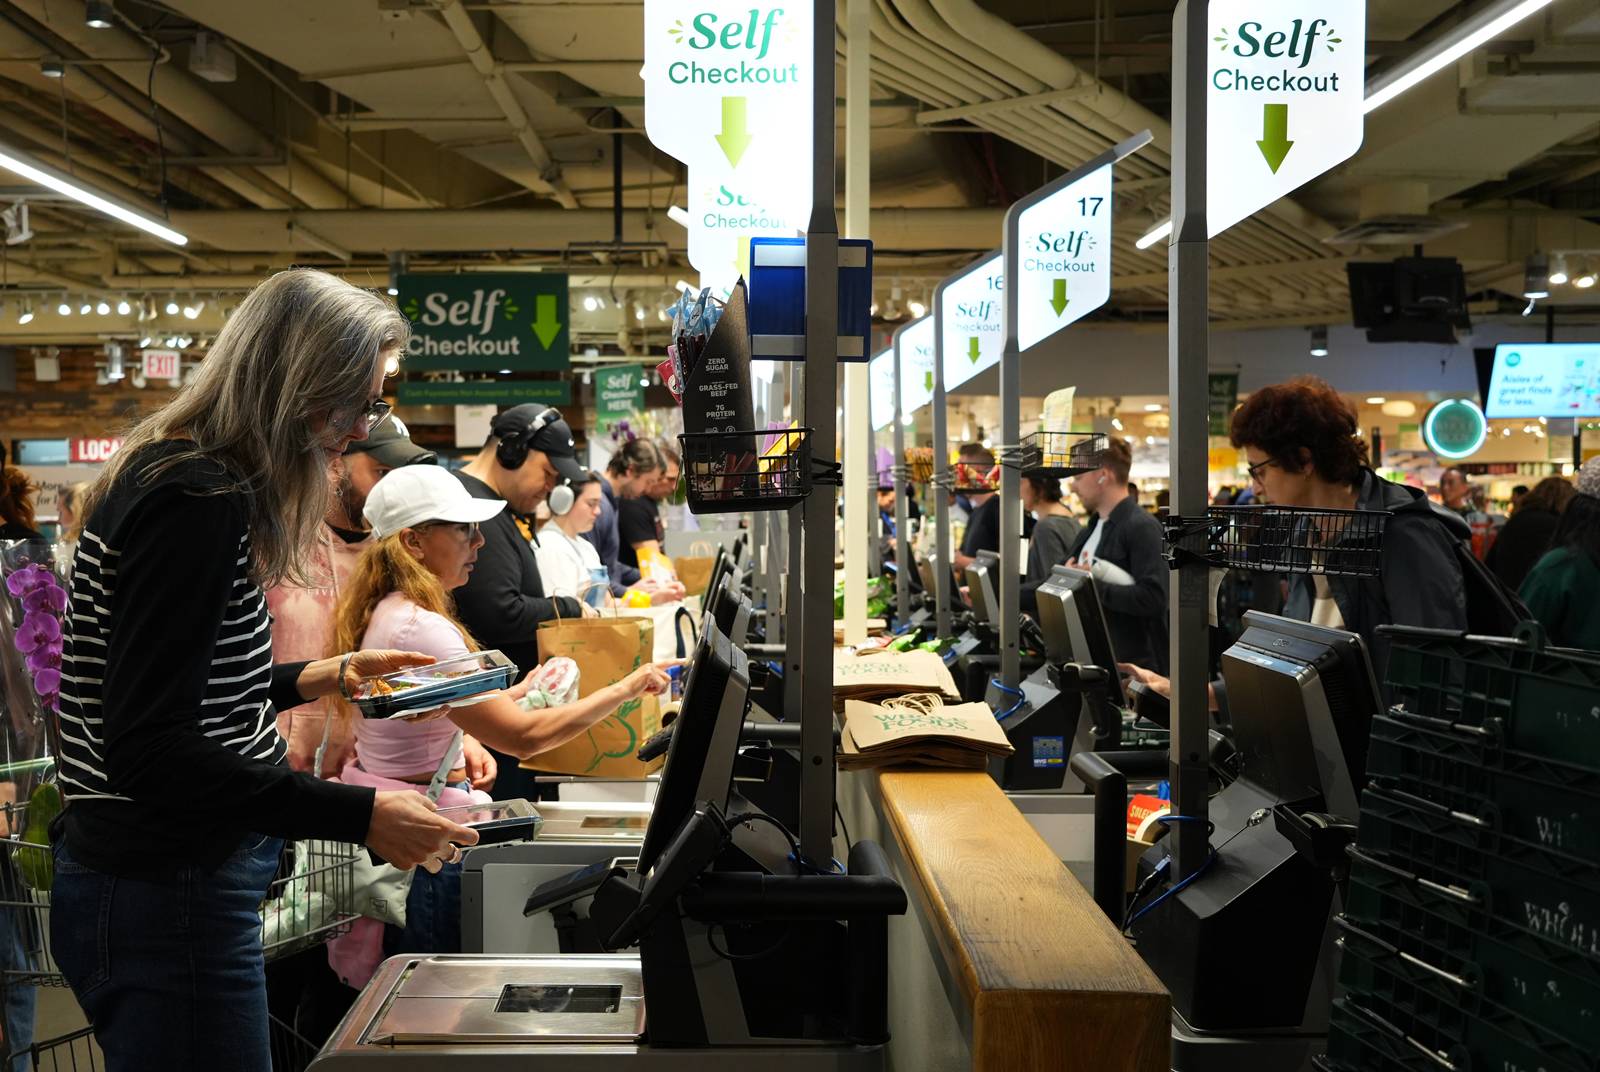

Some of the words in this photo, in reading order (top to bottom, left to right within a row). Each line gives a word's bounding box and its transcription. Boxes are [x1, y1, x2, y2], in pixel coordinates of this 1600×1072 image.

[688, 8, 785, 60] Self
[1233, 18, 1328, 69] Self
[668, 60, 799, 85] Checkout
[1213, 67, 1340, 92] Checkout
[1077, 196, 1104, 217] 17
[1035, 230, 1089, 259] Self
[1024, 258, 1096, 273] Checkout
[986, 275, 1003, 290] 16
[421, 288, 506, 336] Self
[955, 300, 994, 321] Self
[407, 334, 521, 356] Checkout
[147, 354, 176, 378] EXIT
[705, 364, 729, 372] SUGAR
[708, 357, 726, 365] ZERO
[607, 373, 634, 391] Self
[699, 383, 738, 392] GRASS-FED
[706, 410, 736, 418] PROTEIN
[79, 439, 125, 460] LOCA
